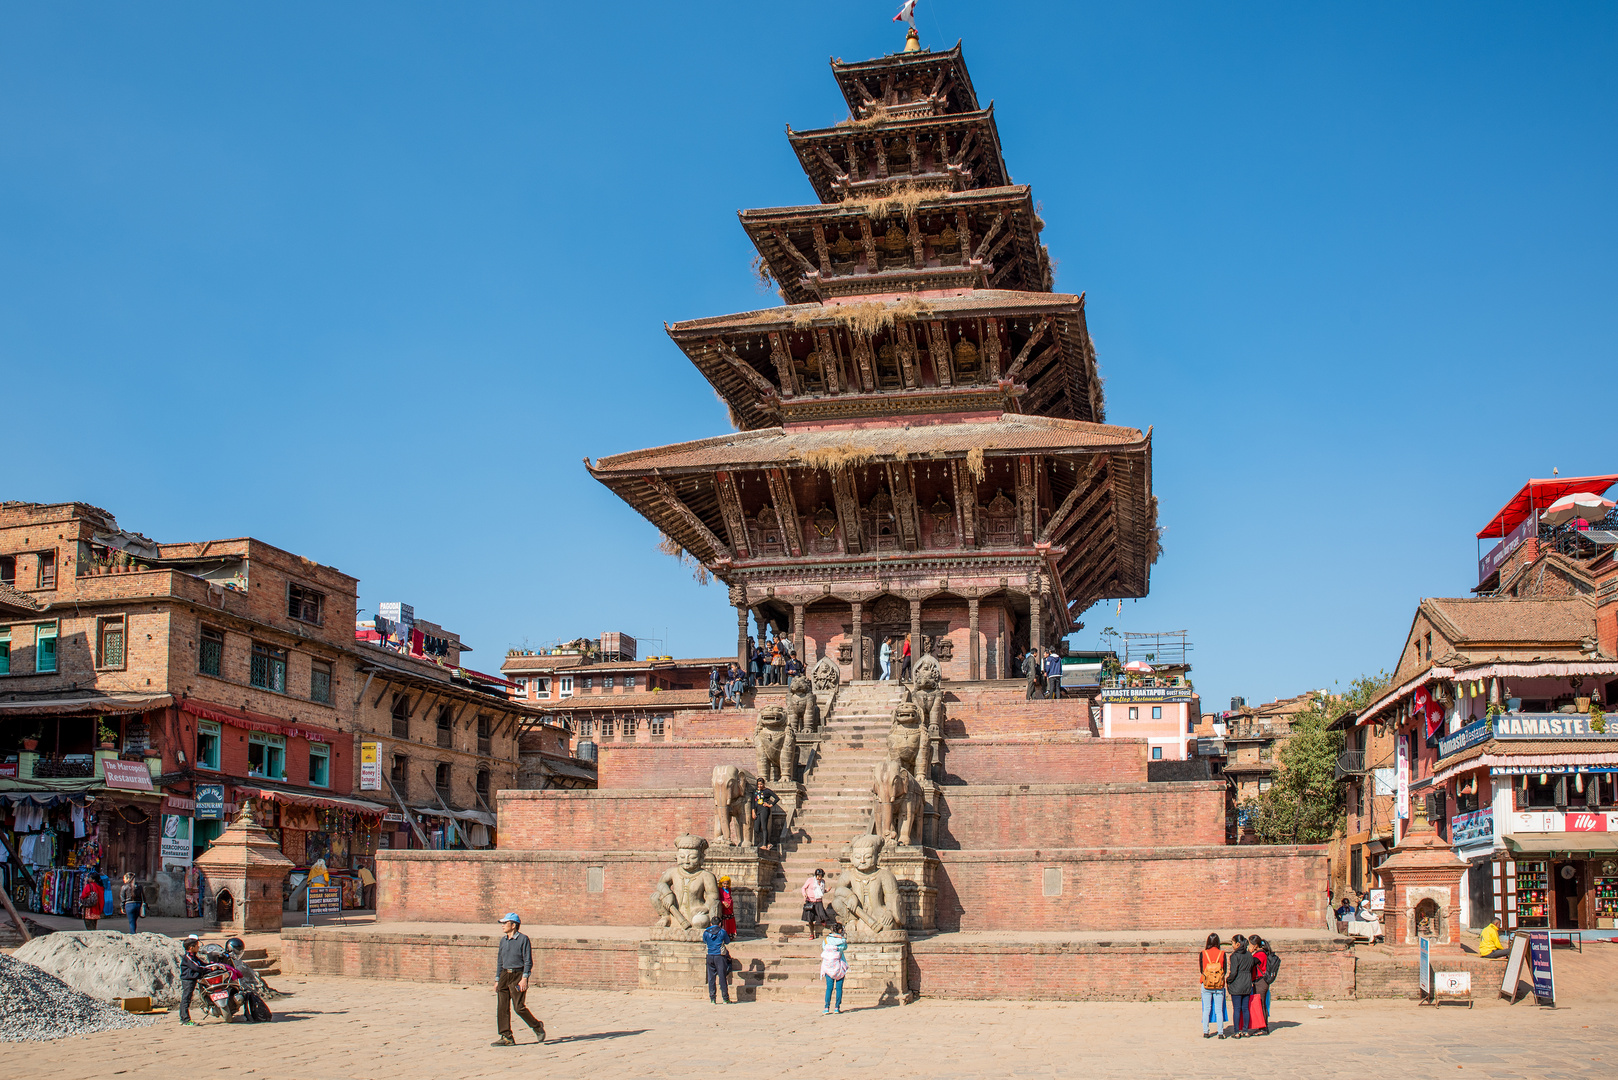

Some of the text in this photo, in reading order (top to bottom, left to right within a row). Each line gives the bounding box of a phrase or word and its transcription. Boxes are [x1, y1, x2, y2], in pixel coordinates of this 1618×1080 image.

[1600, 585, 1616, 595] HOME
[380, 602, 399, 610] PAGODA
[1102, 689, 1129, 697] NAMASTE
[1498, 719, 1583, 735] NAMASTE
[1439, 730, 1466, 756] Namaste
[105, 761, 147, 773] The Marcopolo
[107, 772, 150, 785] Restaurant
[196, 788, 222, 801] MARCO POLO
[1574, 814, 1597, 831] illy
